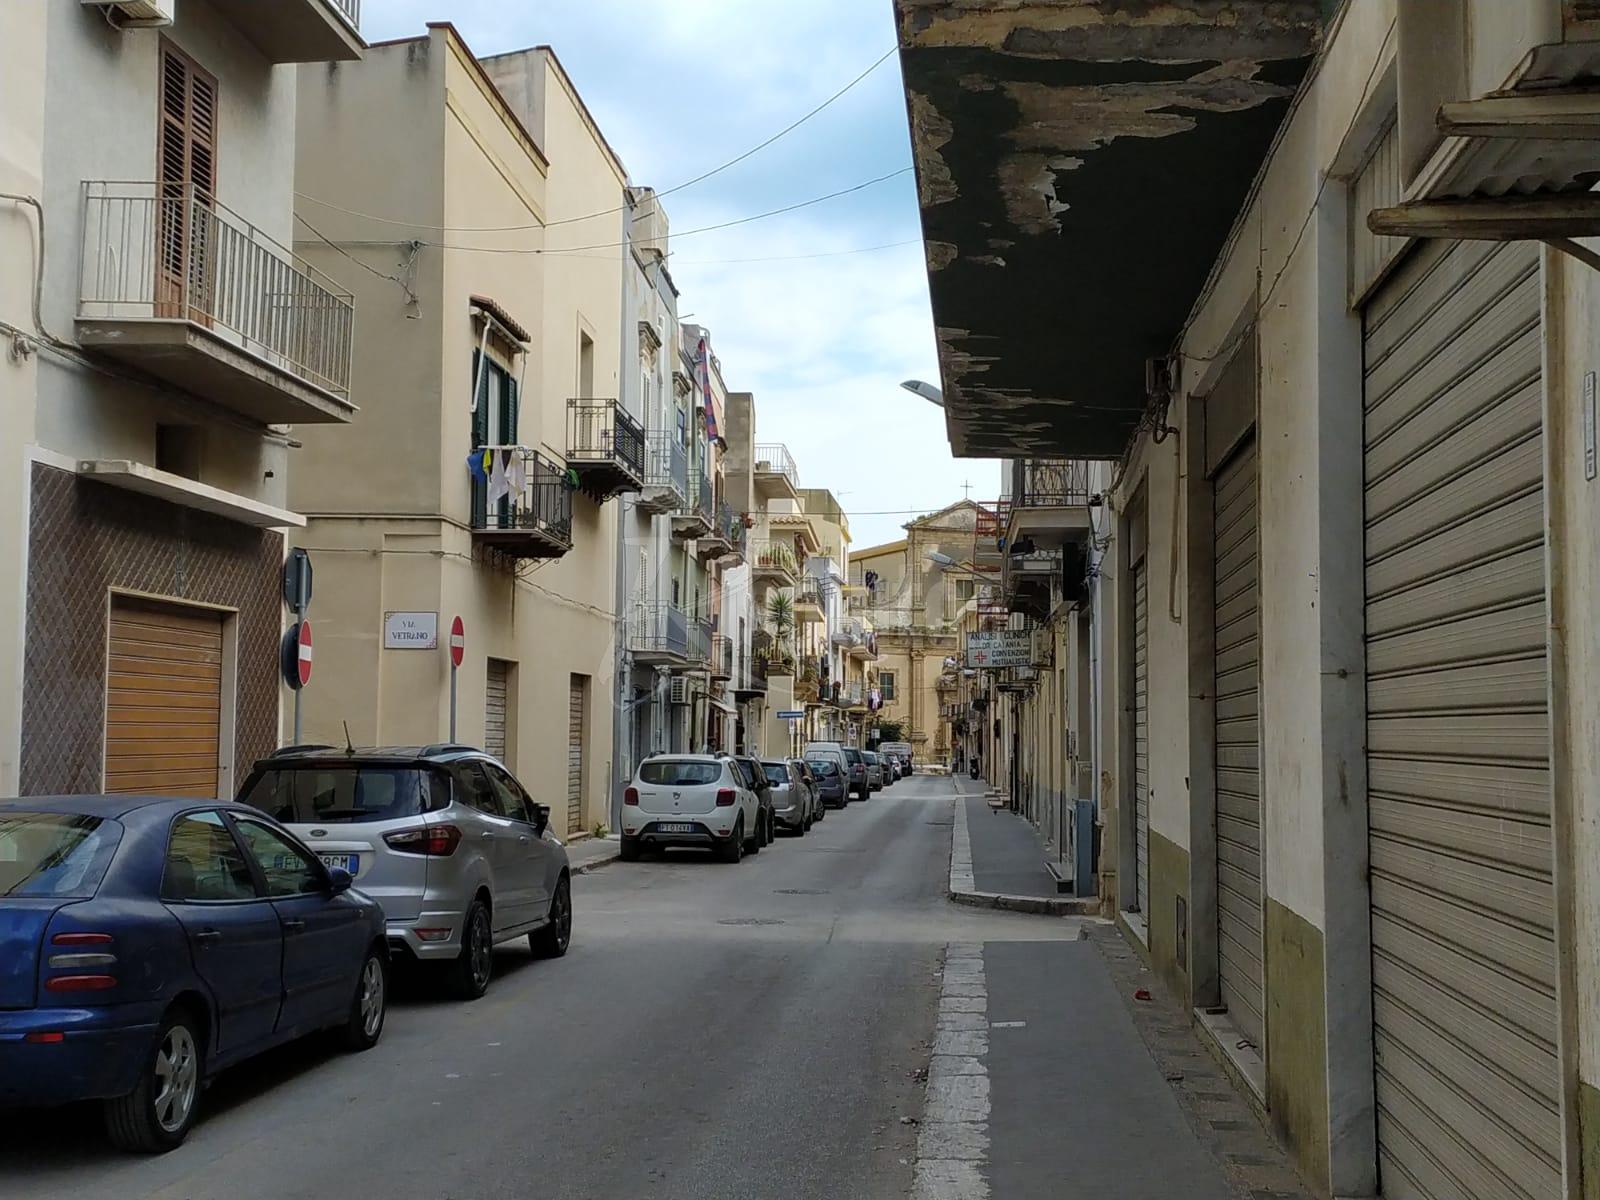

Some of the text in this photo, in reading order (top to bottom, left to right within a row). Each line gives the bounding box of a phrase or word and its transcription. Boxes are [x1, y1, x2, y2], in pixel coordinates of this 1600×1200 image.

[402, 620, 416, 628] VIA
[391, 631, 429, 640] VETRANO
[971, 631, 1031, 641] ANALISI CLINICH
[993, 641, 1021, 649] CATANIA
